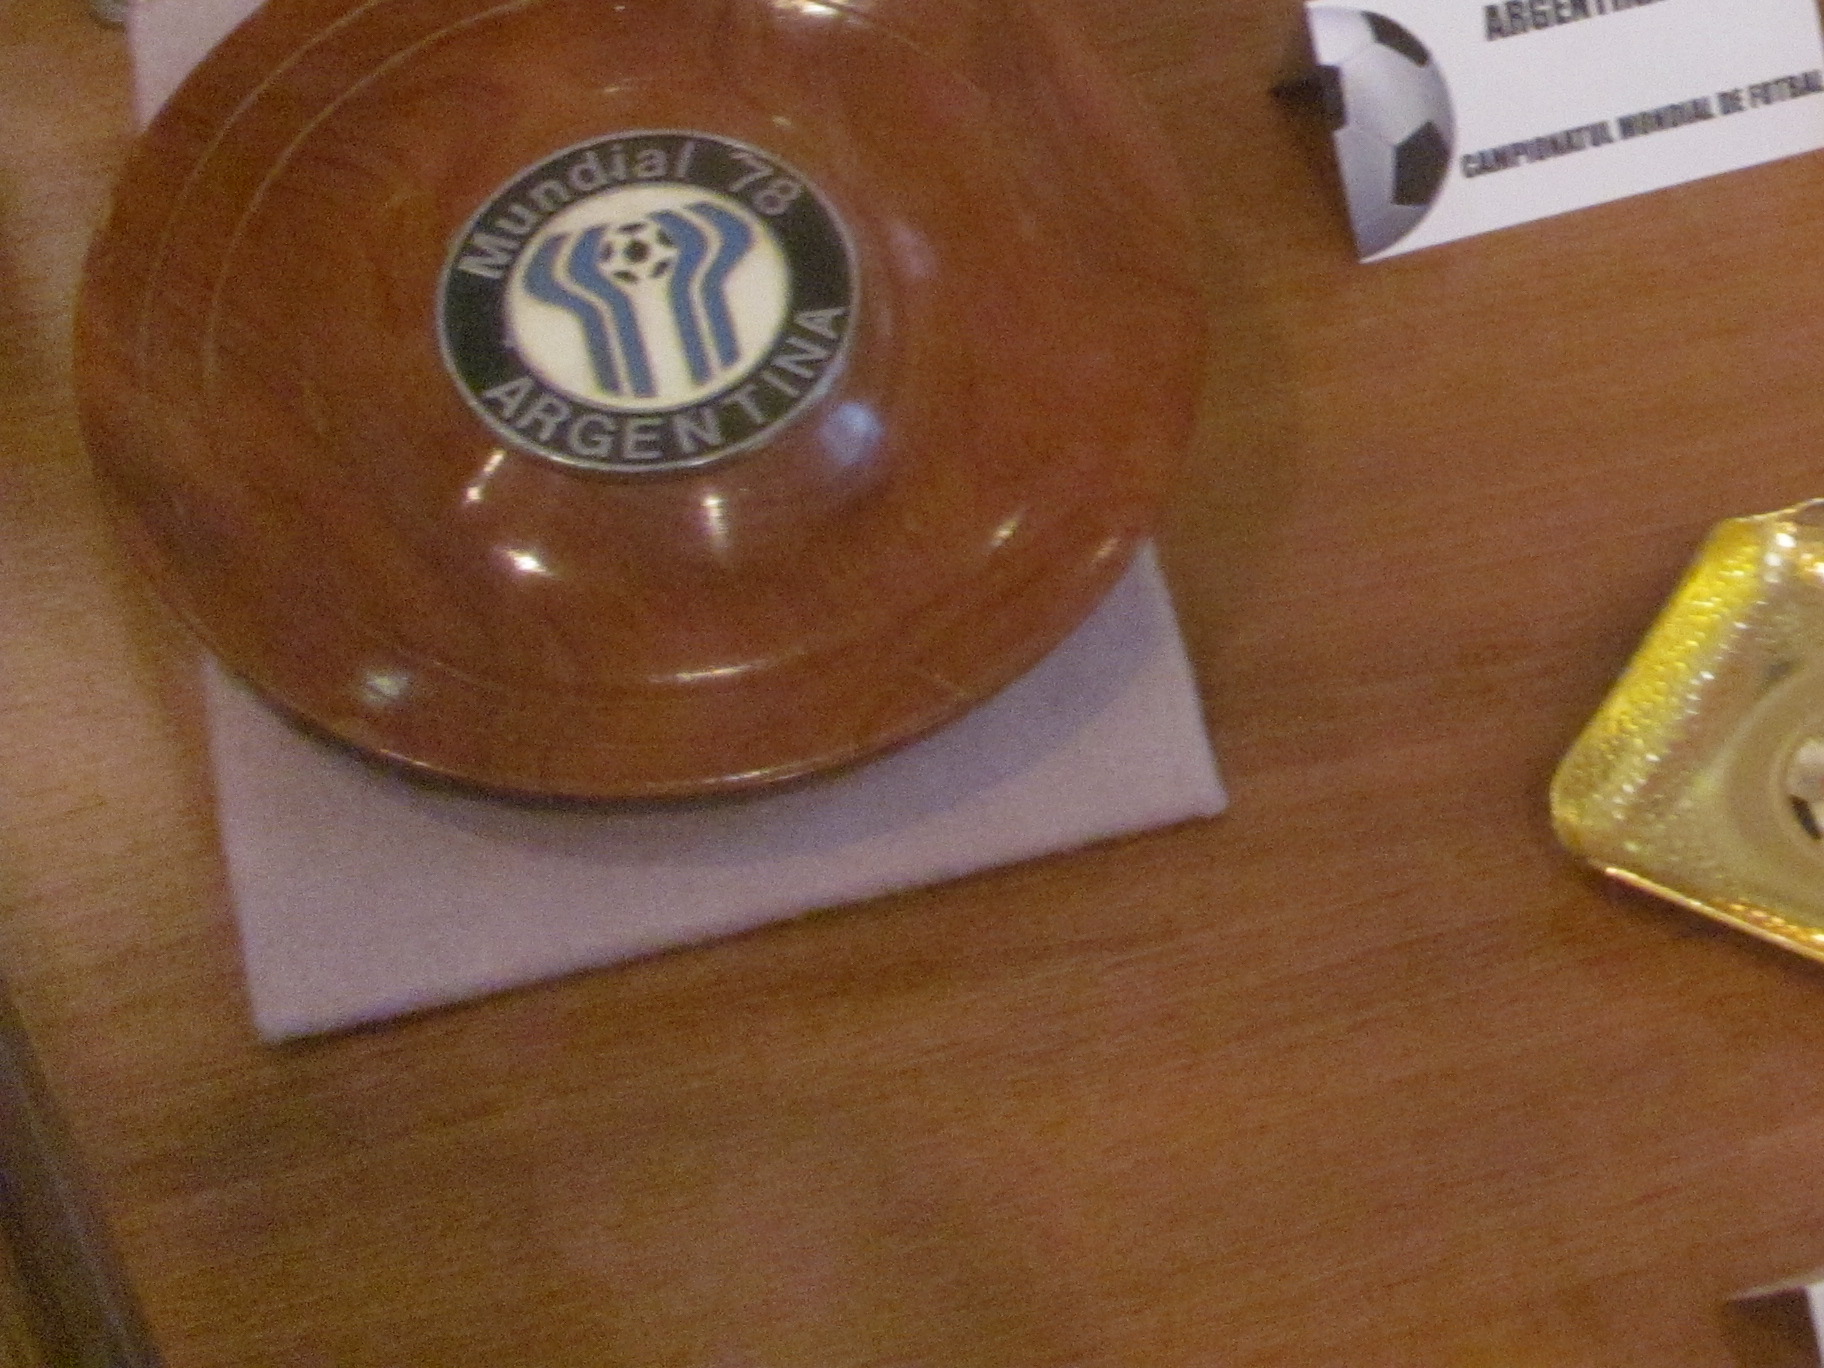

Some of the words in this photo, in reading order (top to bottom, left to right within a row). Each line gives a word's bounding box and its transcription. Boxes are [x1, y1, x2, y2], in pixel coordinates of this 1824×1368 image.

[1715, 88, 1747, 116] DE
[457, 142, 697, 279] Mundial
[727, 151, 802, 217] 78
[483, 306, 847, 459] ARGENTINA
